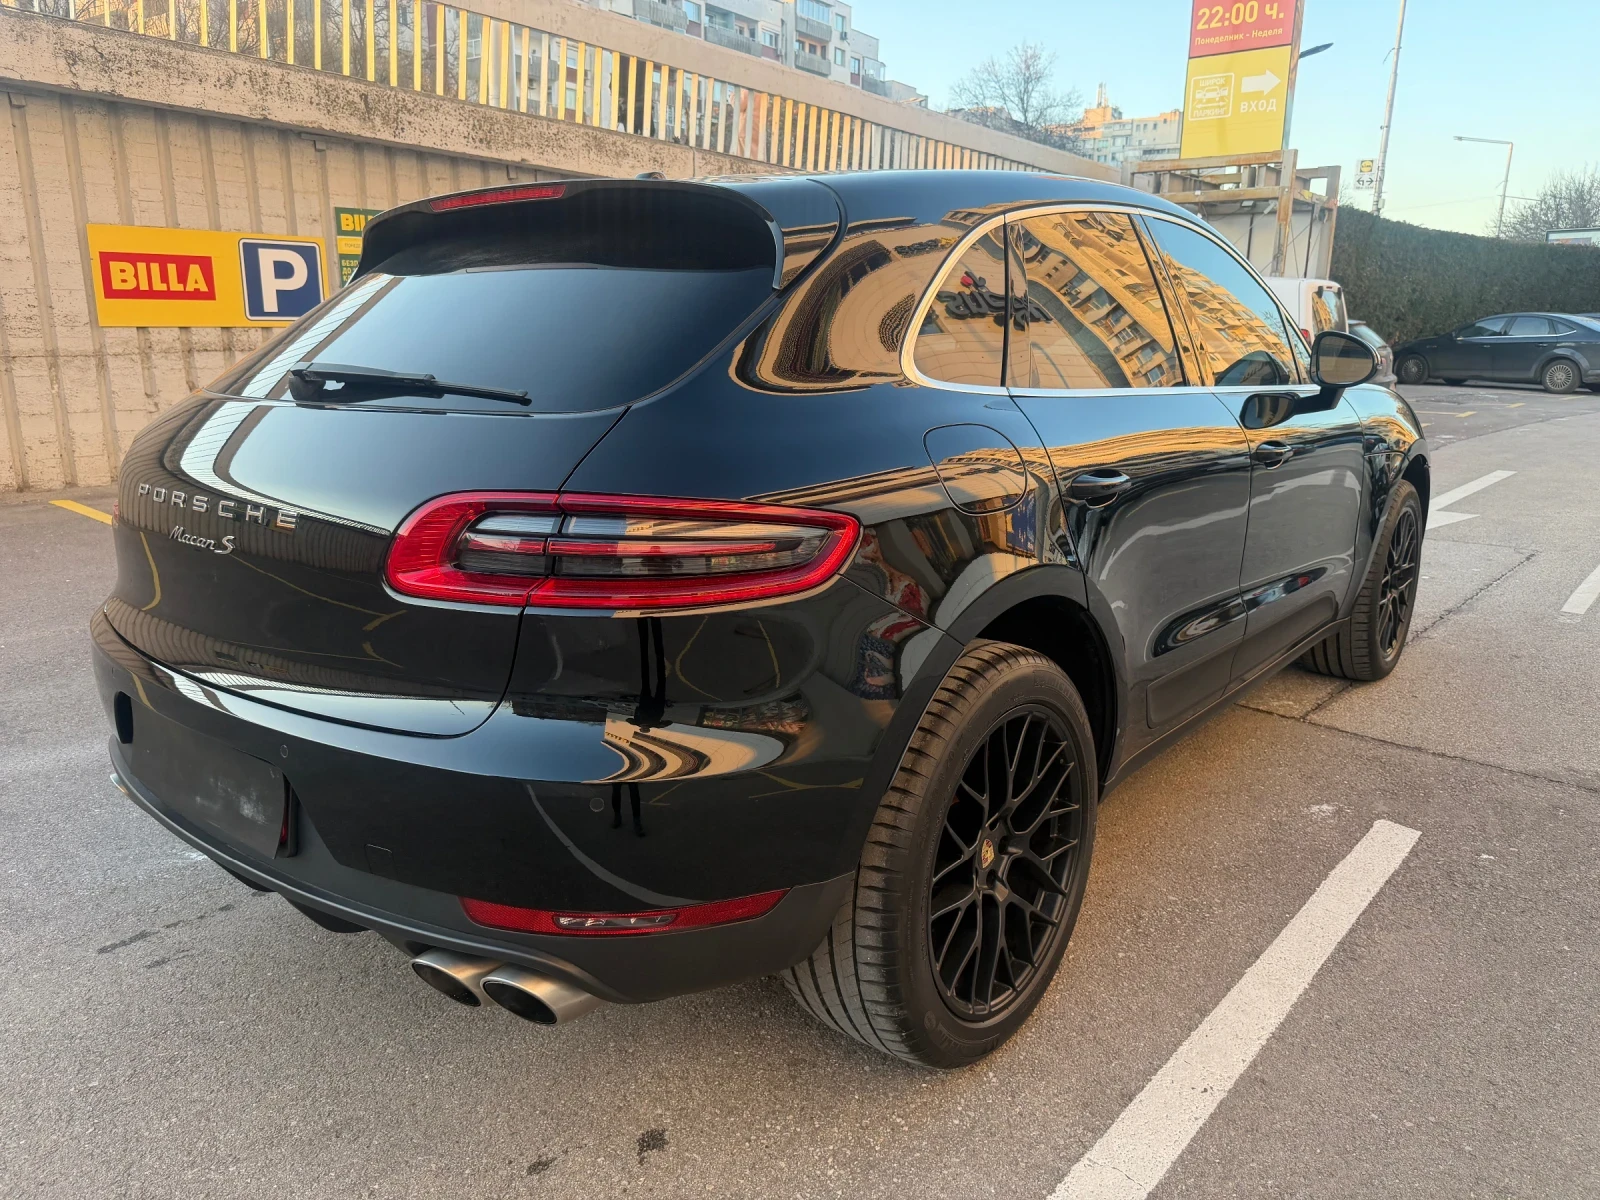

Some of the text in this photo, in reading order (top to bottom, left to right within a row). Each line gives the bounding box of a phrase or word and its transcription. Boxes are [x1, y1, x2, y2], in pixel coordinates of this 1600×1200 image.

[1197, 0, 1284, 30] 22:00 ч.
[1195, 33, 1244, 45] Понеделник
[1252, 28, 1283, 38] Неделя
[1199, 77, 1226, 87] ШИРОК
[1193, 107, 1226, 117] ПАРКИНГ
[1240, 98, 1277, 113] ВХОД
[109, 261, 209, 292] BILLA
[258, 248, 308, 313] P
[138, 483, 299, 528] PORSCHE
[168, 525, 236, 554] Macan S
